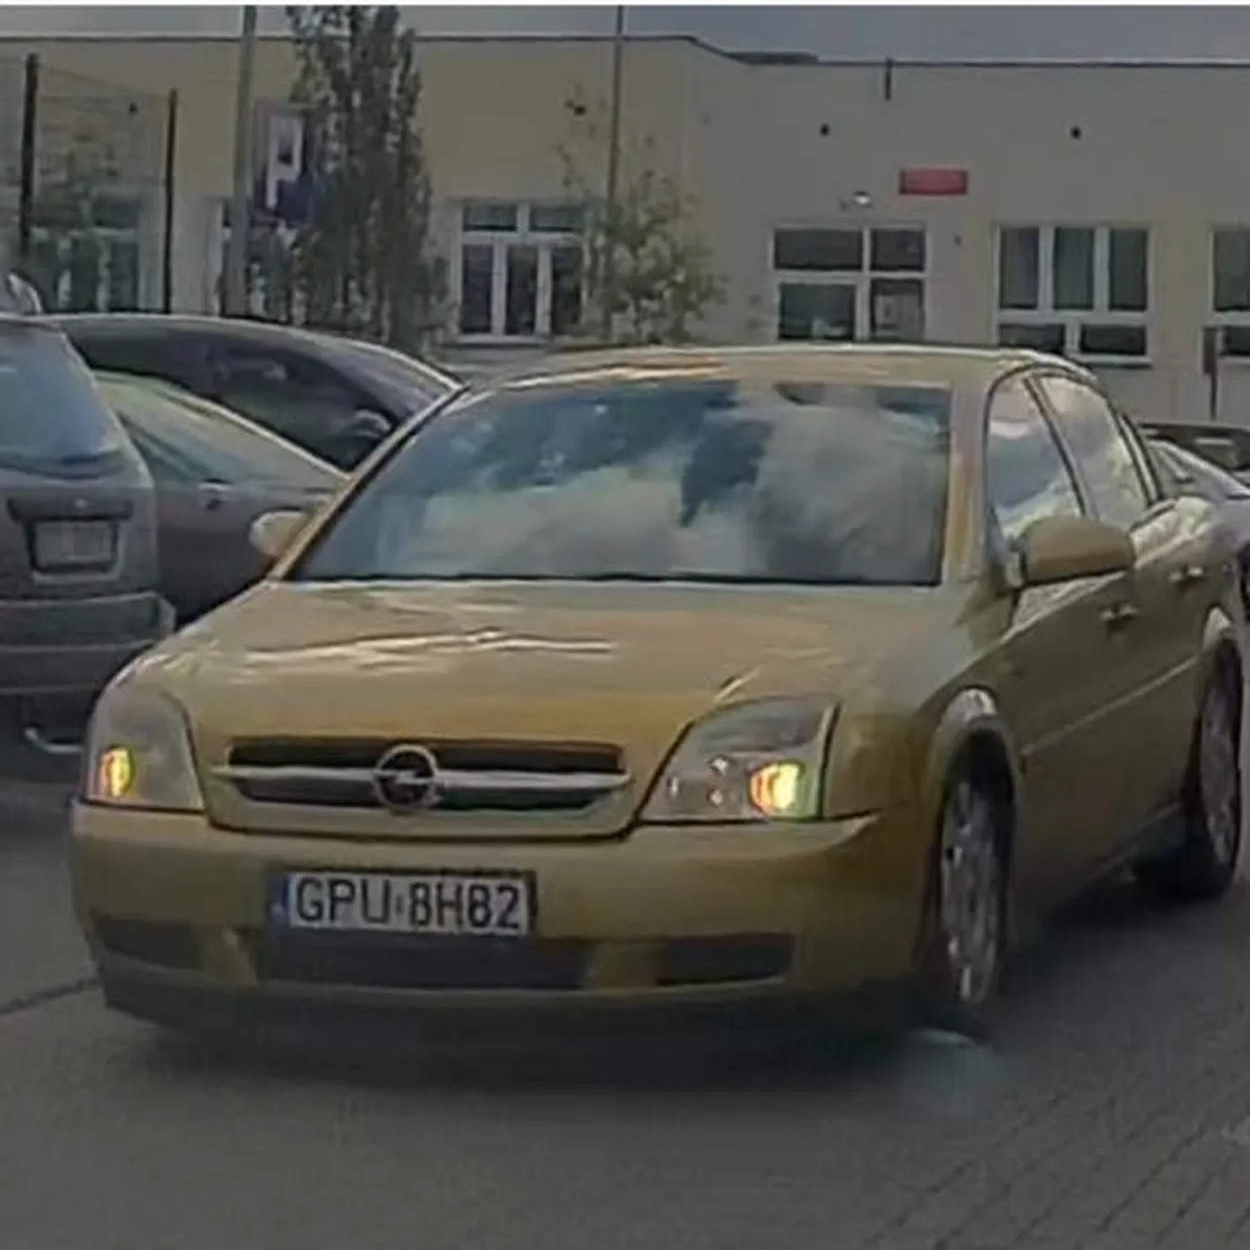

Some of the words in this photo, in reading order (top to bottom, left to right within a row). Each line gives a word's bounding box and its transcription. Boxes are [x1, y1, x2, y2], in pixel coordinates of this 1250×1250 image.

[266, 115, 303, 209] P
[296, 877, 391, 924] GPU
[410, 881, 519, 929] 8H82
